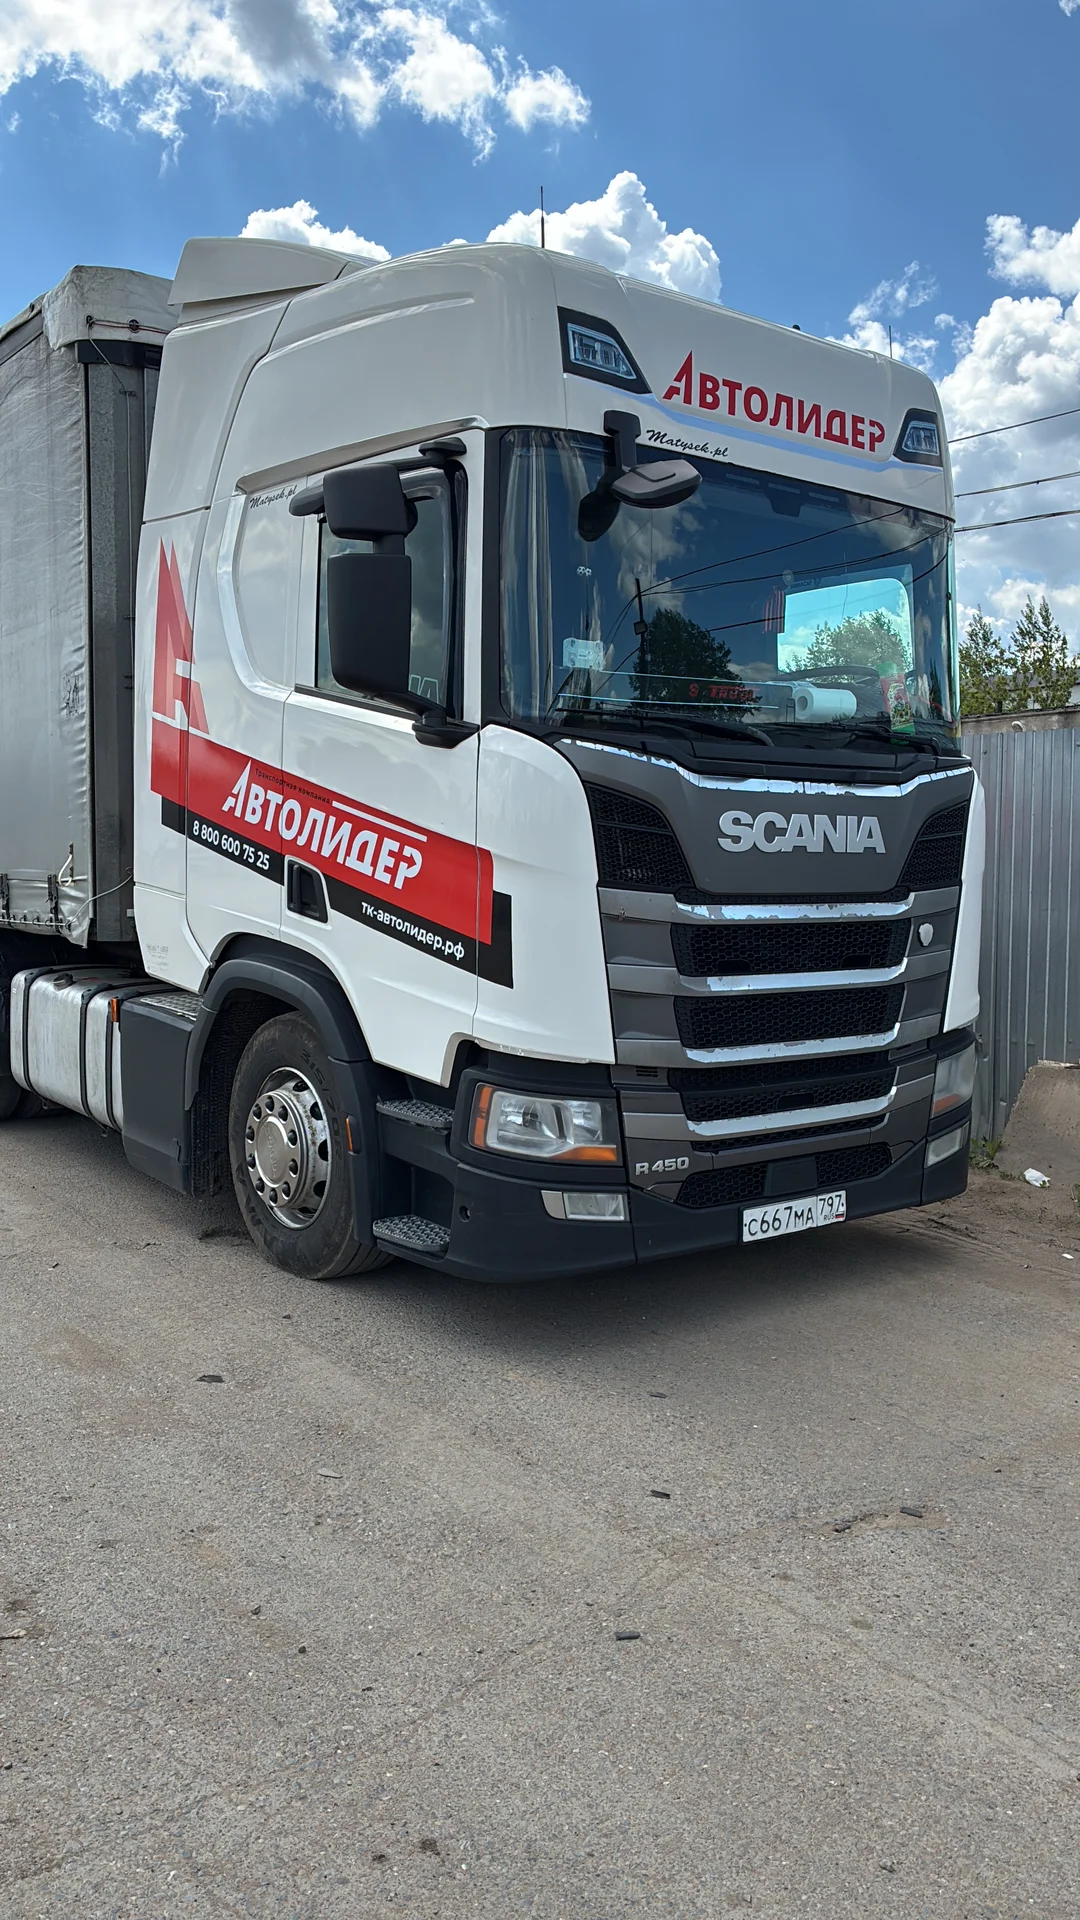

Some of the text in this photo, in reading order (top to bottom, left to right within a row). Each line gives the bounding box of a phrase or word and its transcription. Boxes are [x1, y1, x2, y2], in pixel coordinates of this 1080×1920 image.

[646, 429, 729, 457] Matysek.pl
[249, 484, 298, 509] Matysek.pl
[192, 820, 270, 870] 8 800 600 75 25
[717, 810, 886, 854] SCANIA
[361, 901, 465, 961] тк-автолидер.рф
[635, 1156, 690, 1176] R 450
[818, 1194, 842, 1217] 797
[823, 1212, 834, 1221] RUS
